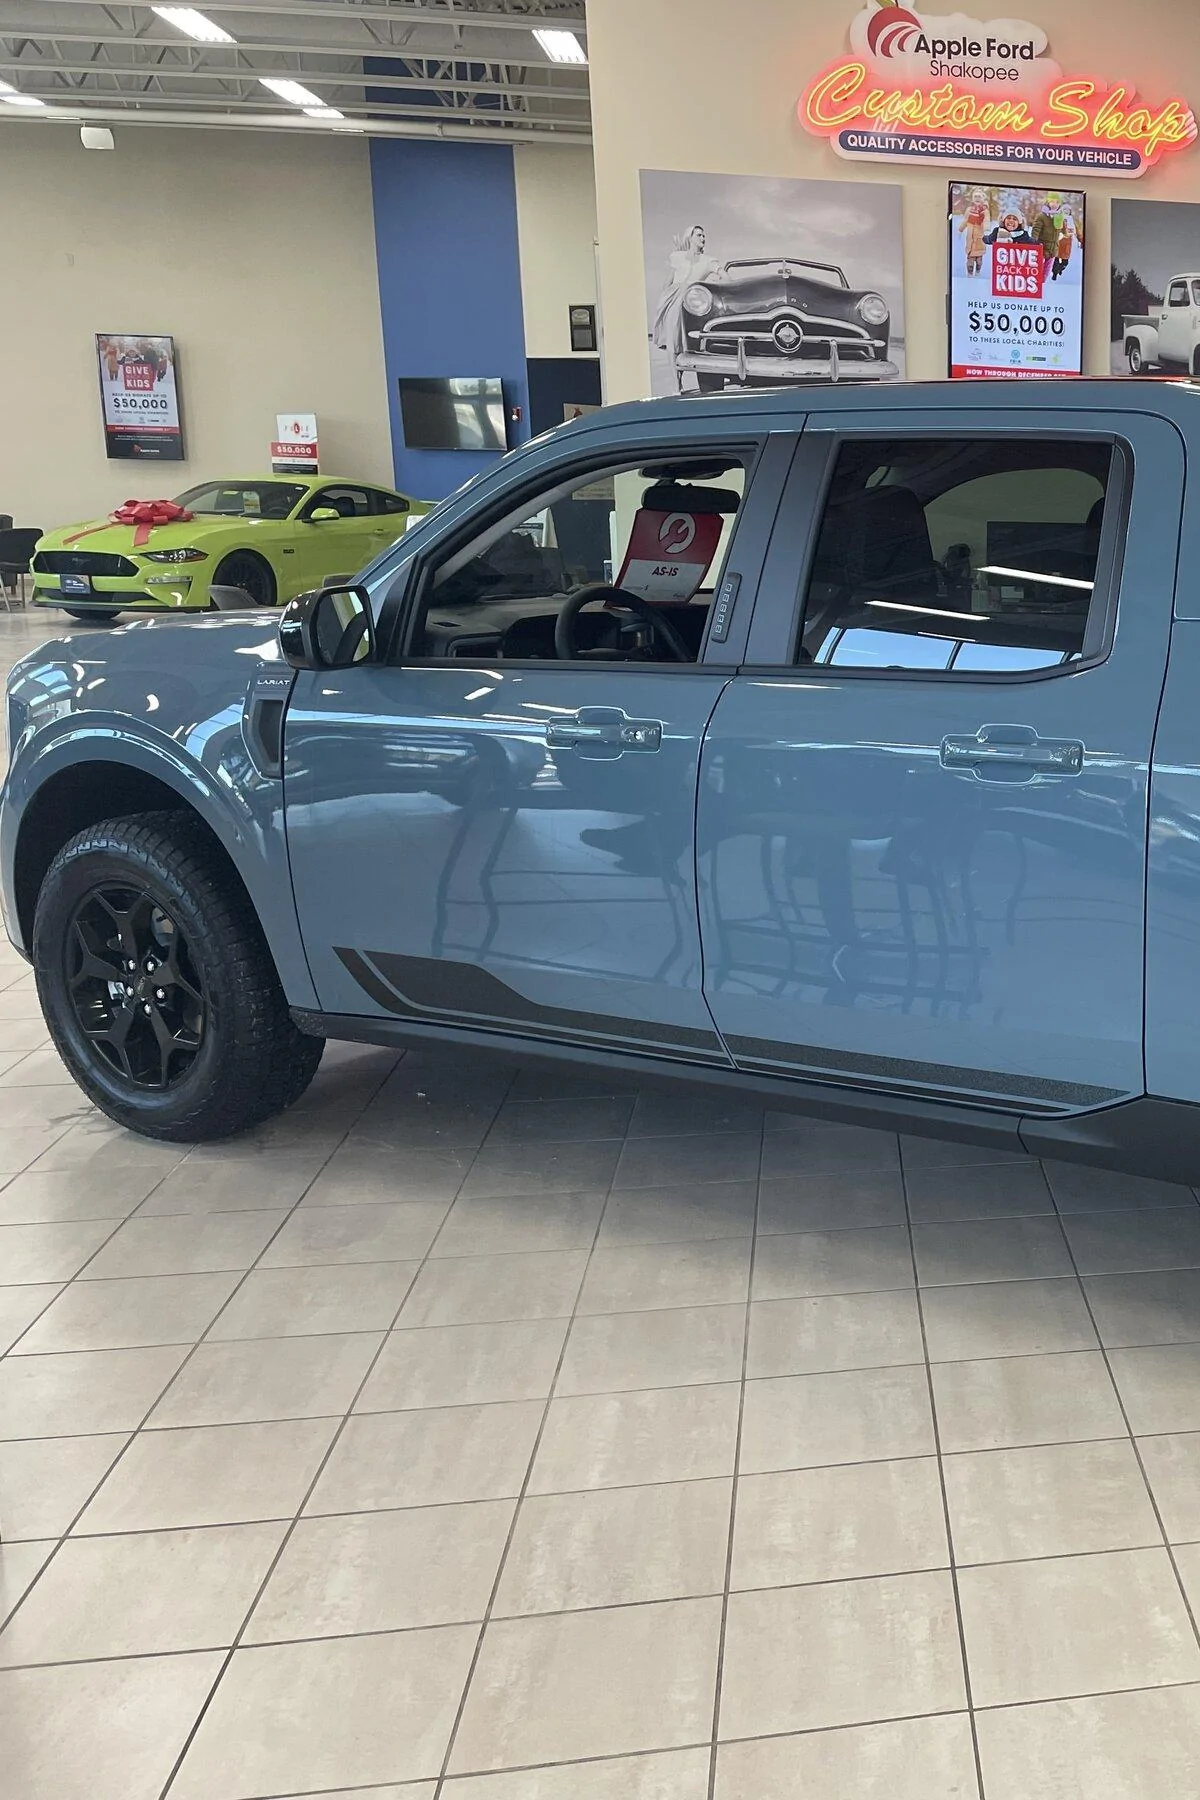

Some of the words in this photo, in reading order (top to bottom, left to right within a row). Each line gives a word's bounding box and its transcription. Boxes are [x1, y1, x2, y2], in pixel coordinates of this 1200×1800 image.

[914, 34, 981, 60] Apple
[986, 38, 1034, 60] Ford
[930, 60, 1019, 83] Shakopee
[806, 63, 1034, 133] Custom
[1041, 81, 1196, 157] Shop
[847, 134, 906, 152] QUALITY
[908, 138, 1004, 157] ACCESSORIES
[1007, 145, 1034, 159] FOR
[1037, 148, 1075, 163] YOUR
[1076, 150, 1132, 166] VEHICLE
[996, 247, 1039, 268] GIVE
[996, 265, 1022, 276] BACK
[1025, 266, 1039, 276] TO
[996, 275, 1039, 294] KIDS
[968, 301, 987, 309] HELP
[991, 302, 1001, 310] US
[1004, 303, 1037, 312] DONATE
[1040, 304, 1051, 313] UP
[1054, 306, 1065, 314] TO
[969, 311, 1066, 336] $50,000
[980, 336, 1001, 345] THESE
[1002, 338, 1026, 346] LOCAL
[125, 366, 150, 374] GIVE
[984, 370, 1017, 378] THROUGH
[126, 379, 150, 388] KIDS
[113, 398, 168, 410] $50,000
[276, 446, 312, 454] $50,000
[652, 566, 679, 577] AS-IS
